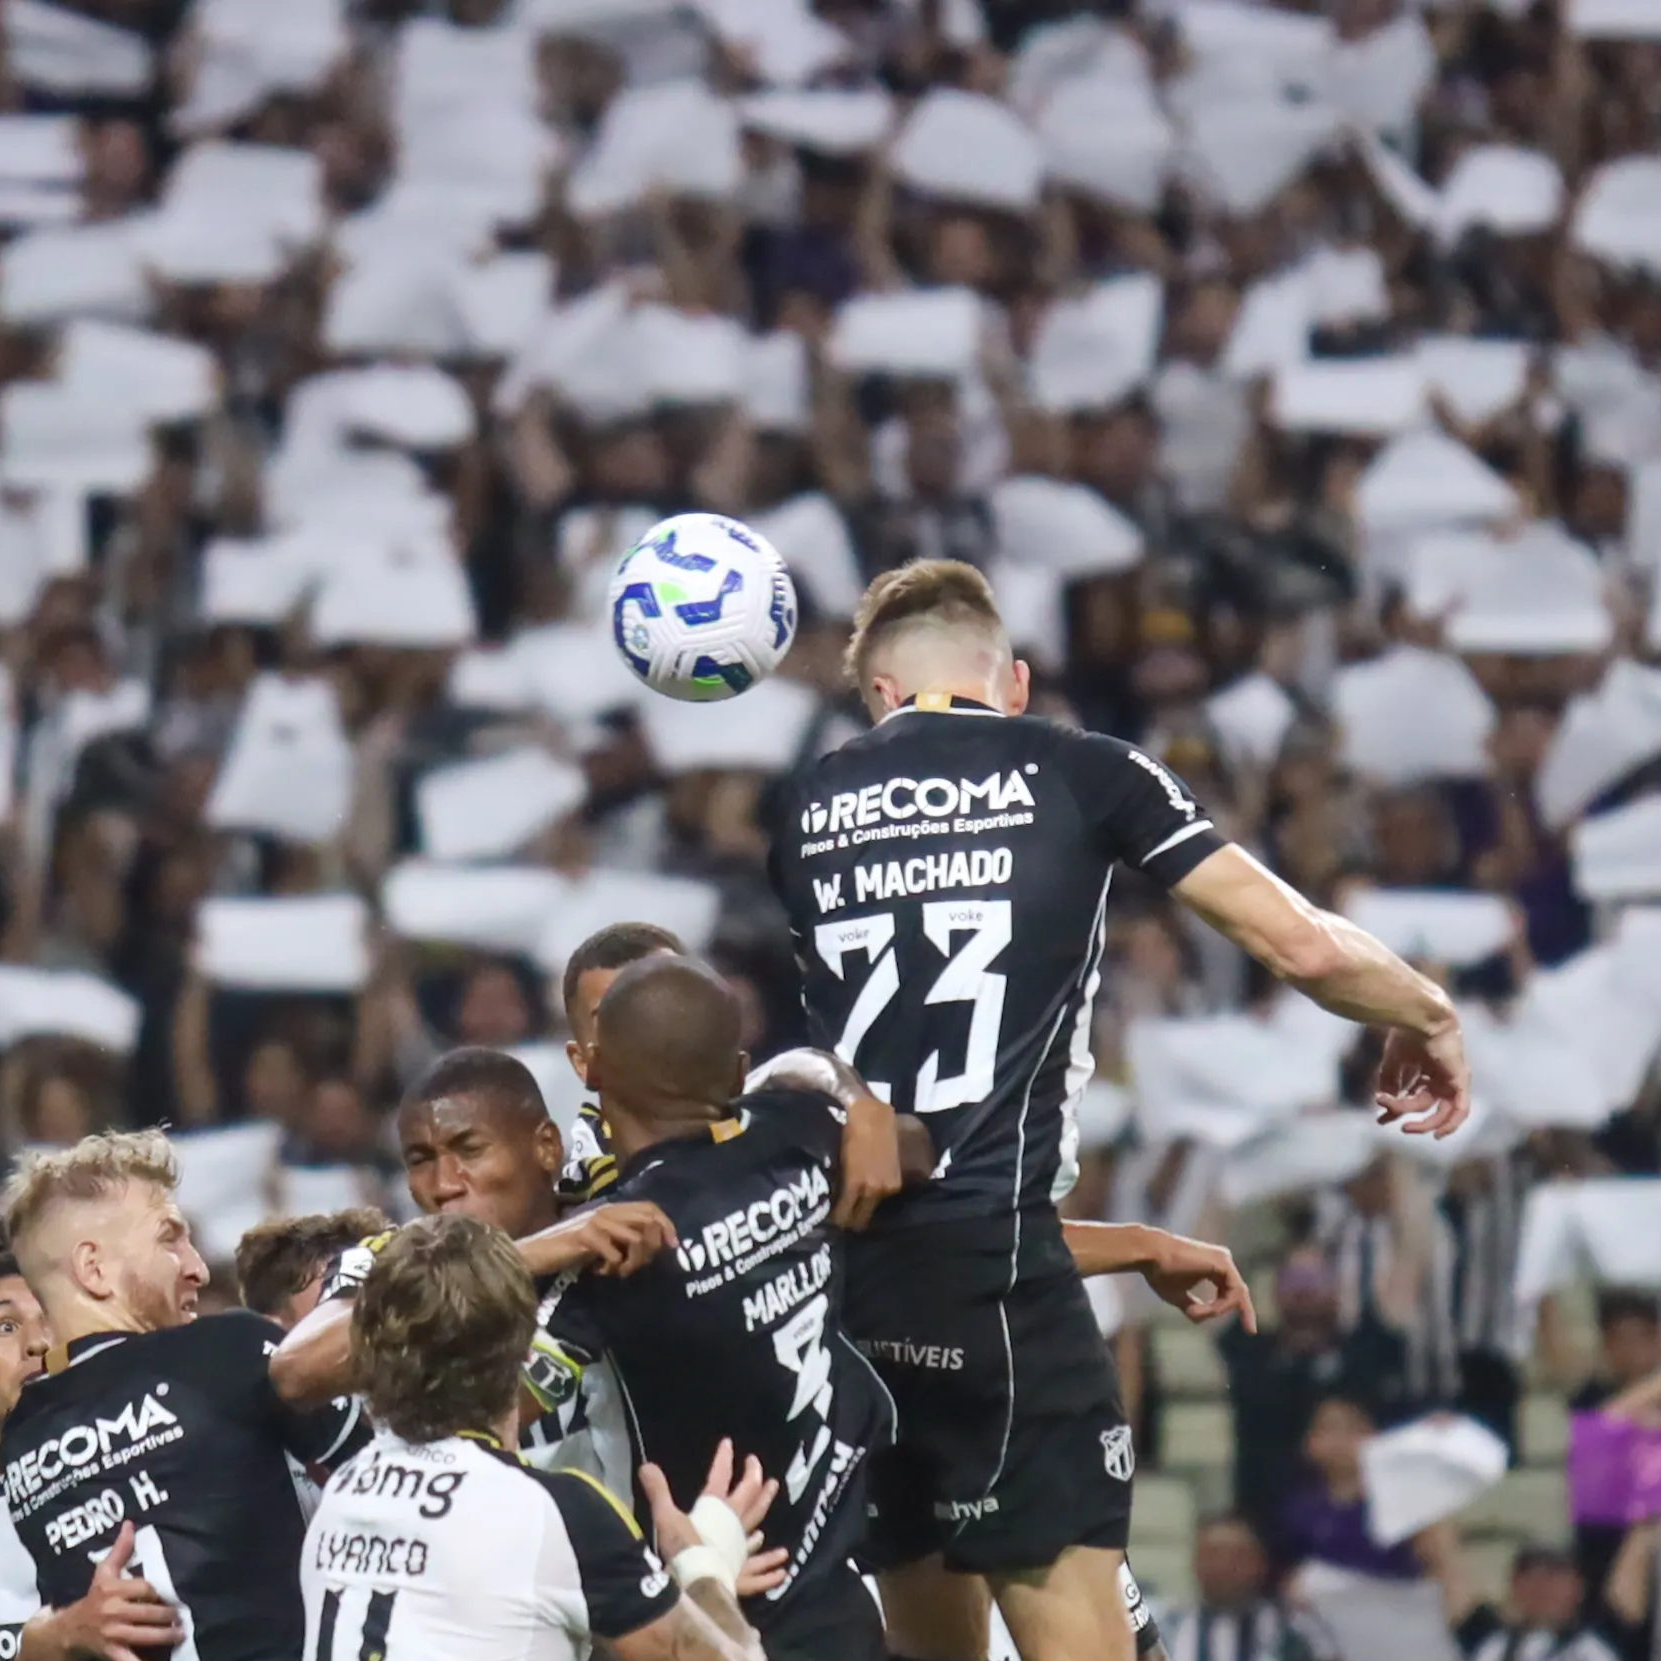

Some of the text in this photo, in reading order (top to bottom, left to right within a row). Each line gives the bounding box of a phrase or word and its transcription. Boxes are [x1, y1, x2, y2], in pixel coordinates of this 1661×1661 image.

[829, 770, 1036, 832] RECOMA
[852, 821, 950, 845] Construções
[954, 811, 1034, 834] Esportivas
[855, 847, 1013, 902] MACHADO
[838, 928, 870, 943] voke
[948, 909, 985, 923] voke
[702, 1164, 829, 1268] RECOMA
[686, 1273, 724, 1299] Pisos
[6, 1393, 177, 1504] RECOMA
[102, 1425, 185, 1470] Esportivas
[45, 1470, 170, 1556] PEDRO H.
[315, 1531, 428, 1576] LYANCO
